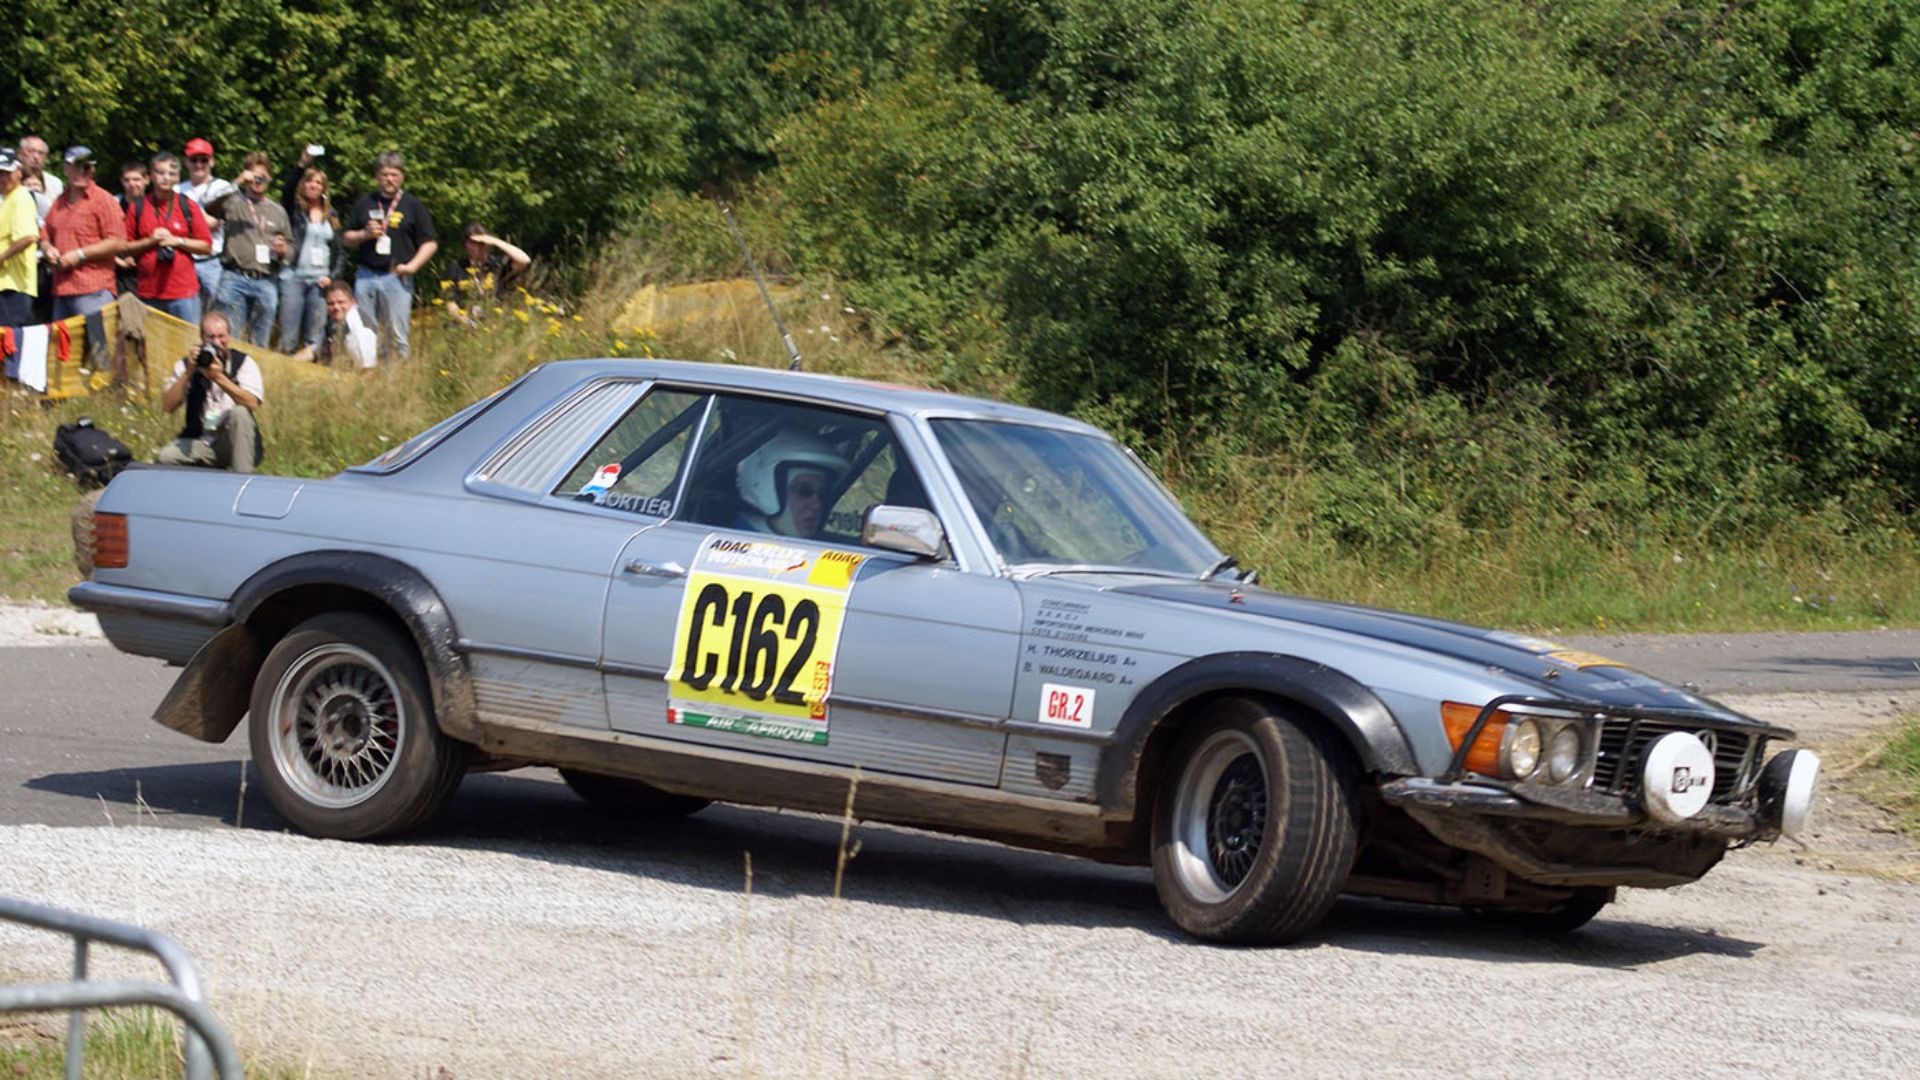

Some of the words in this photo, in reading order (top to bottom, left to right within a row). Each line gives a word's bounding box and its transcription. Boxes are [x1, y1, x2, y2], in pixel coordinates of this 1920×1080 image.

[595, 491, 672, 516] ORTIER
[709, 538, 751, 554] ADAC
[820, 551, 861, 565] ADAC
[681, 583, 821, 707] C162
[1043, 645, 1118, 666] THORZELIUS
[1039, 664, 1116, 684] WALDEGAARD
[1047, 690, 1085, 723] GR.2
